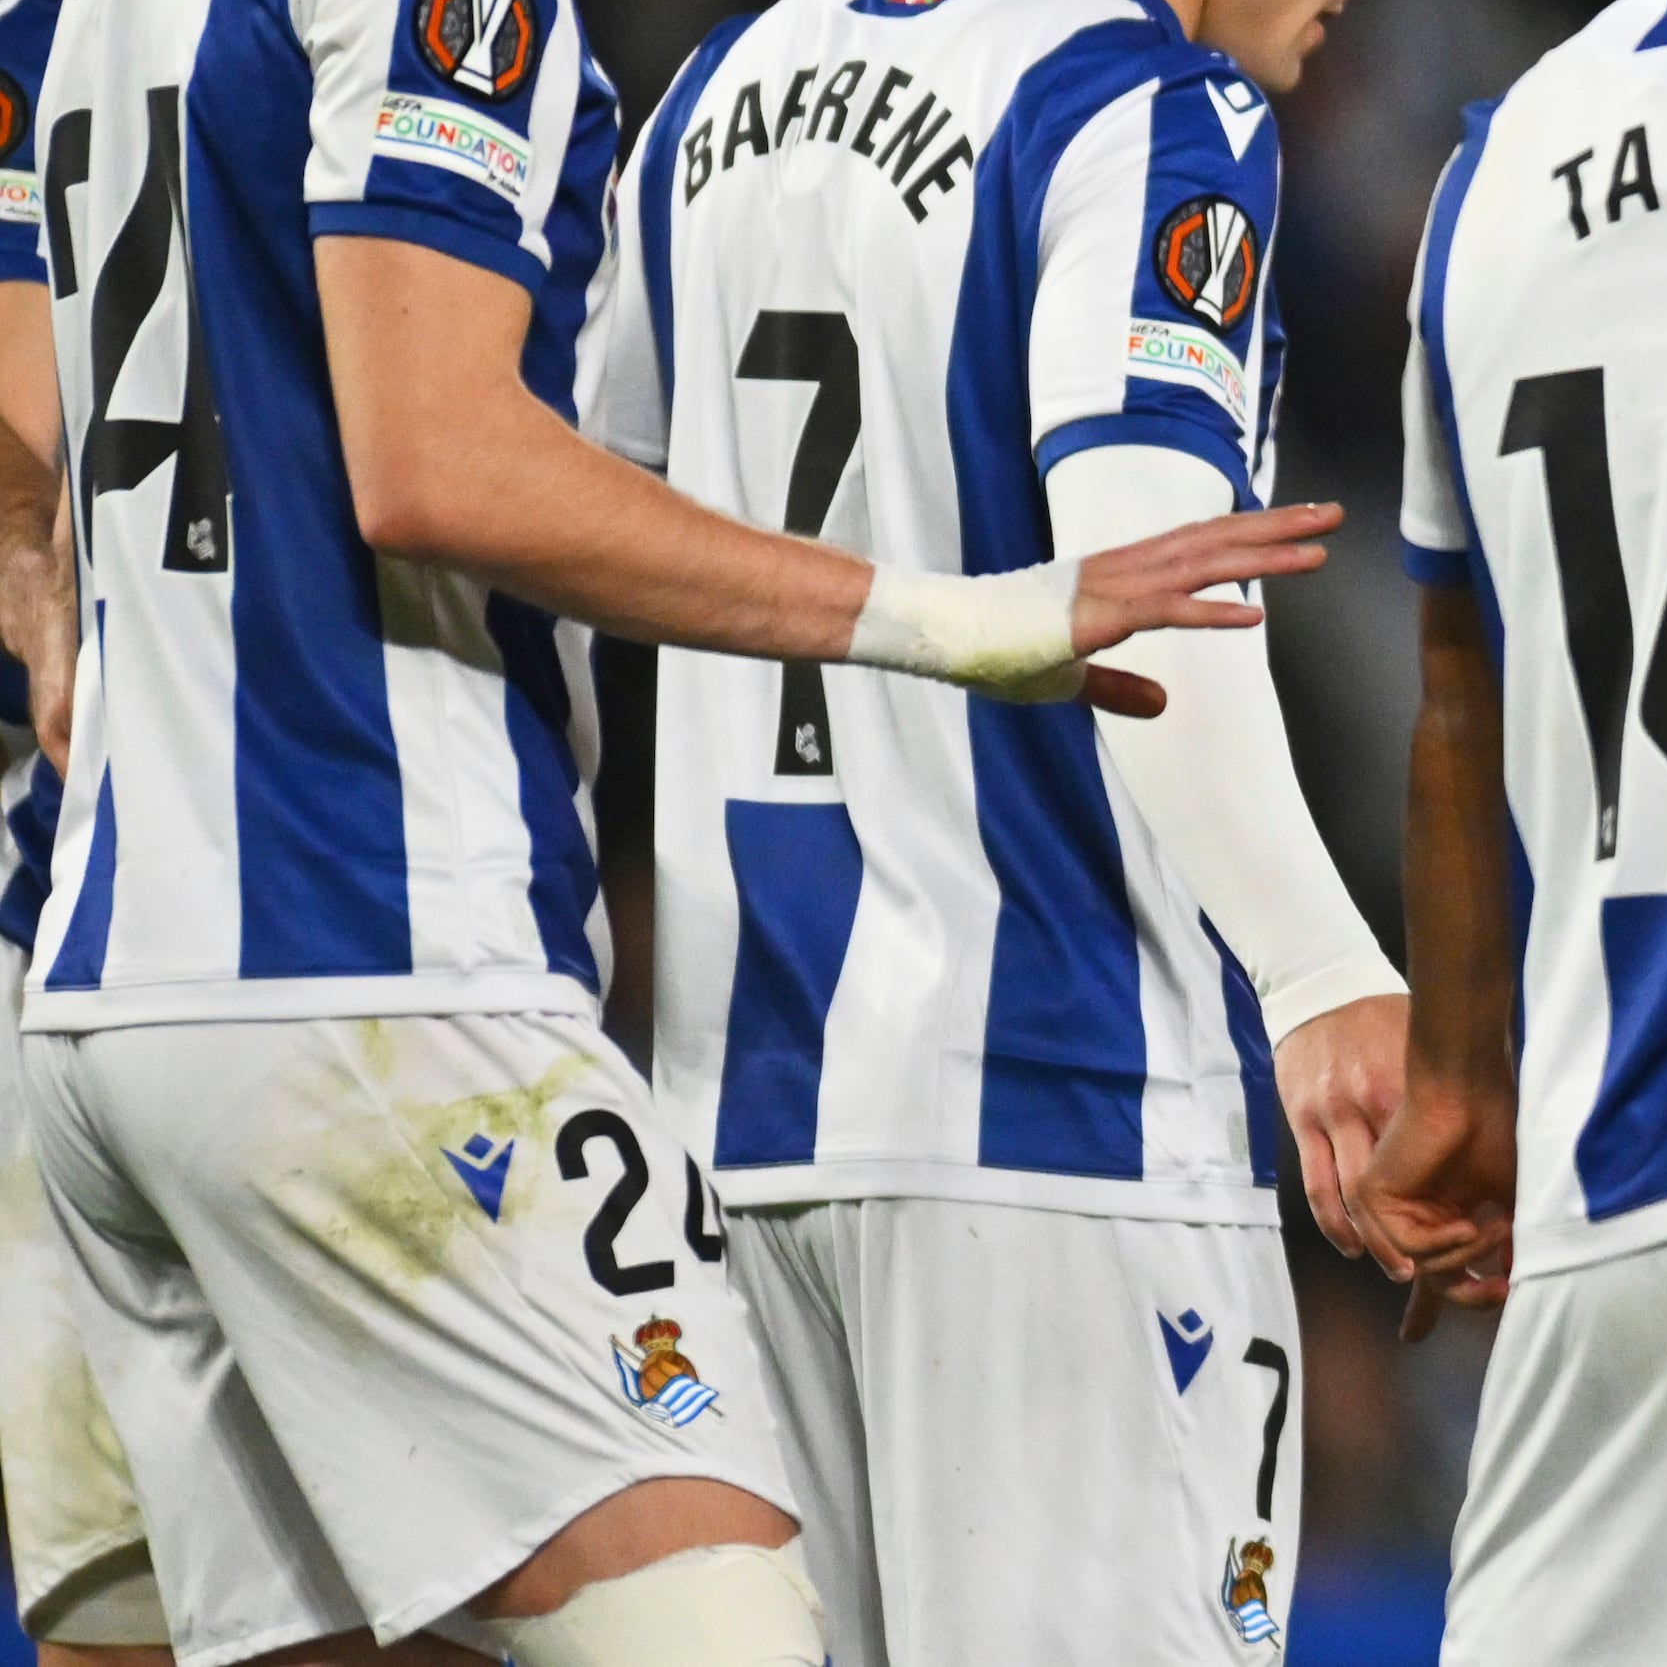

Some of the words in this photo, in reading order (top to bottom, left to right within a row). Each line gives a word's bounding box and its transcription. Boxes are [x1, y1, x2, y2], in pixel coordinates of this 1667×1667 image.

[375, 111, 528, 183] FOUNDATION
[735, 309, 861, 775] 7
[1241, 1336, 1290, 1523] 7
